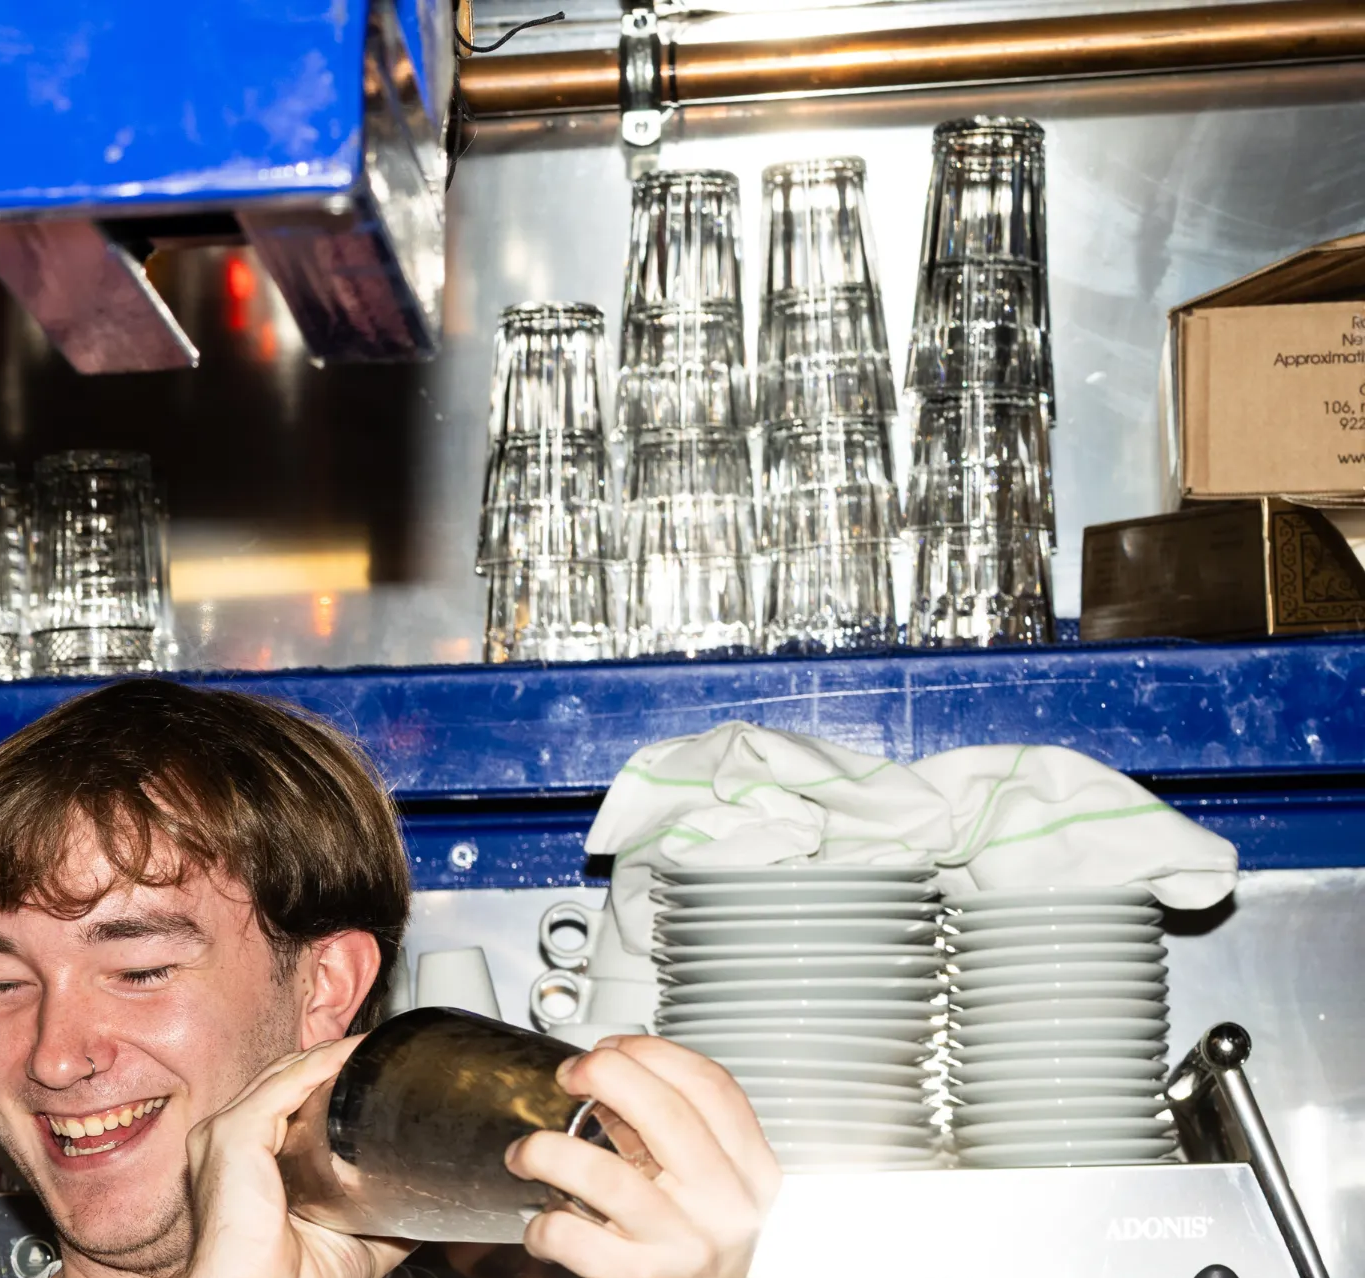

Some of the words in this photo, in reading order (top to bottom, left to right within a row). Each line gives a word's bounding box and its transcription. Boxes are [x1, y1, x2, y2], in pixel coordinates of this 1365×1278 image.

[1342, 333, 1365, 347] Ne
[1324, 401, 1356, 415] 106,
[1106, 1216, 1209, 1242] ADONIS
